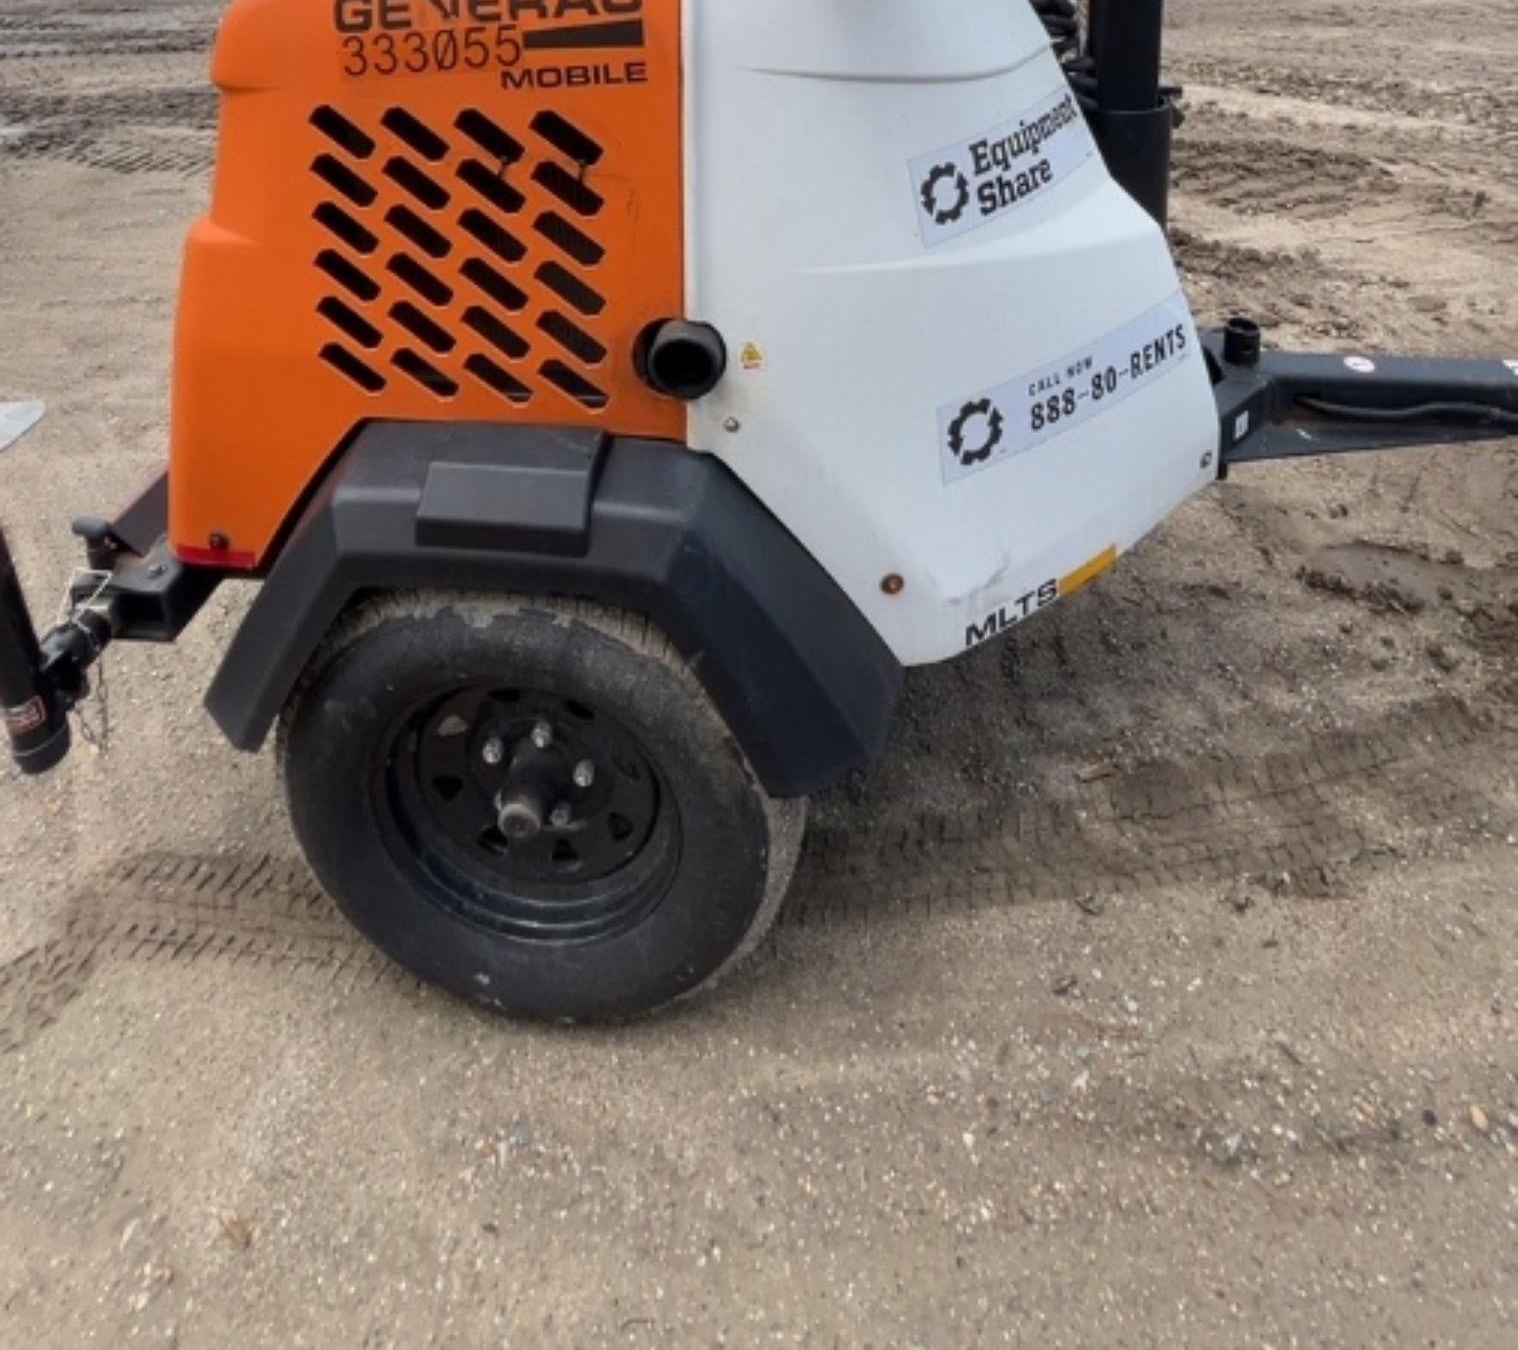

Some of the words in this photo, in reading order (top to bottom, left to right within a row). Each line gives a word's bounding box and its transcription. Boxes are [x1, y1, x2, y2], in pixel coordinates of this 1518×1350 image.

[344, 24, 522, 77] 333055
[501, 61, 649, 90] MOBILE
[968, 92, 1078, 176] Equipment
[976, 158, 1053, 217] Share
[1028, 374, 1061, 397] CALL
[1067, 354, 1094, 378] NOW
[1030, 323, 1186, 431] 888-80-RENTS
[965, 578, 1057, 647] MLTS
